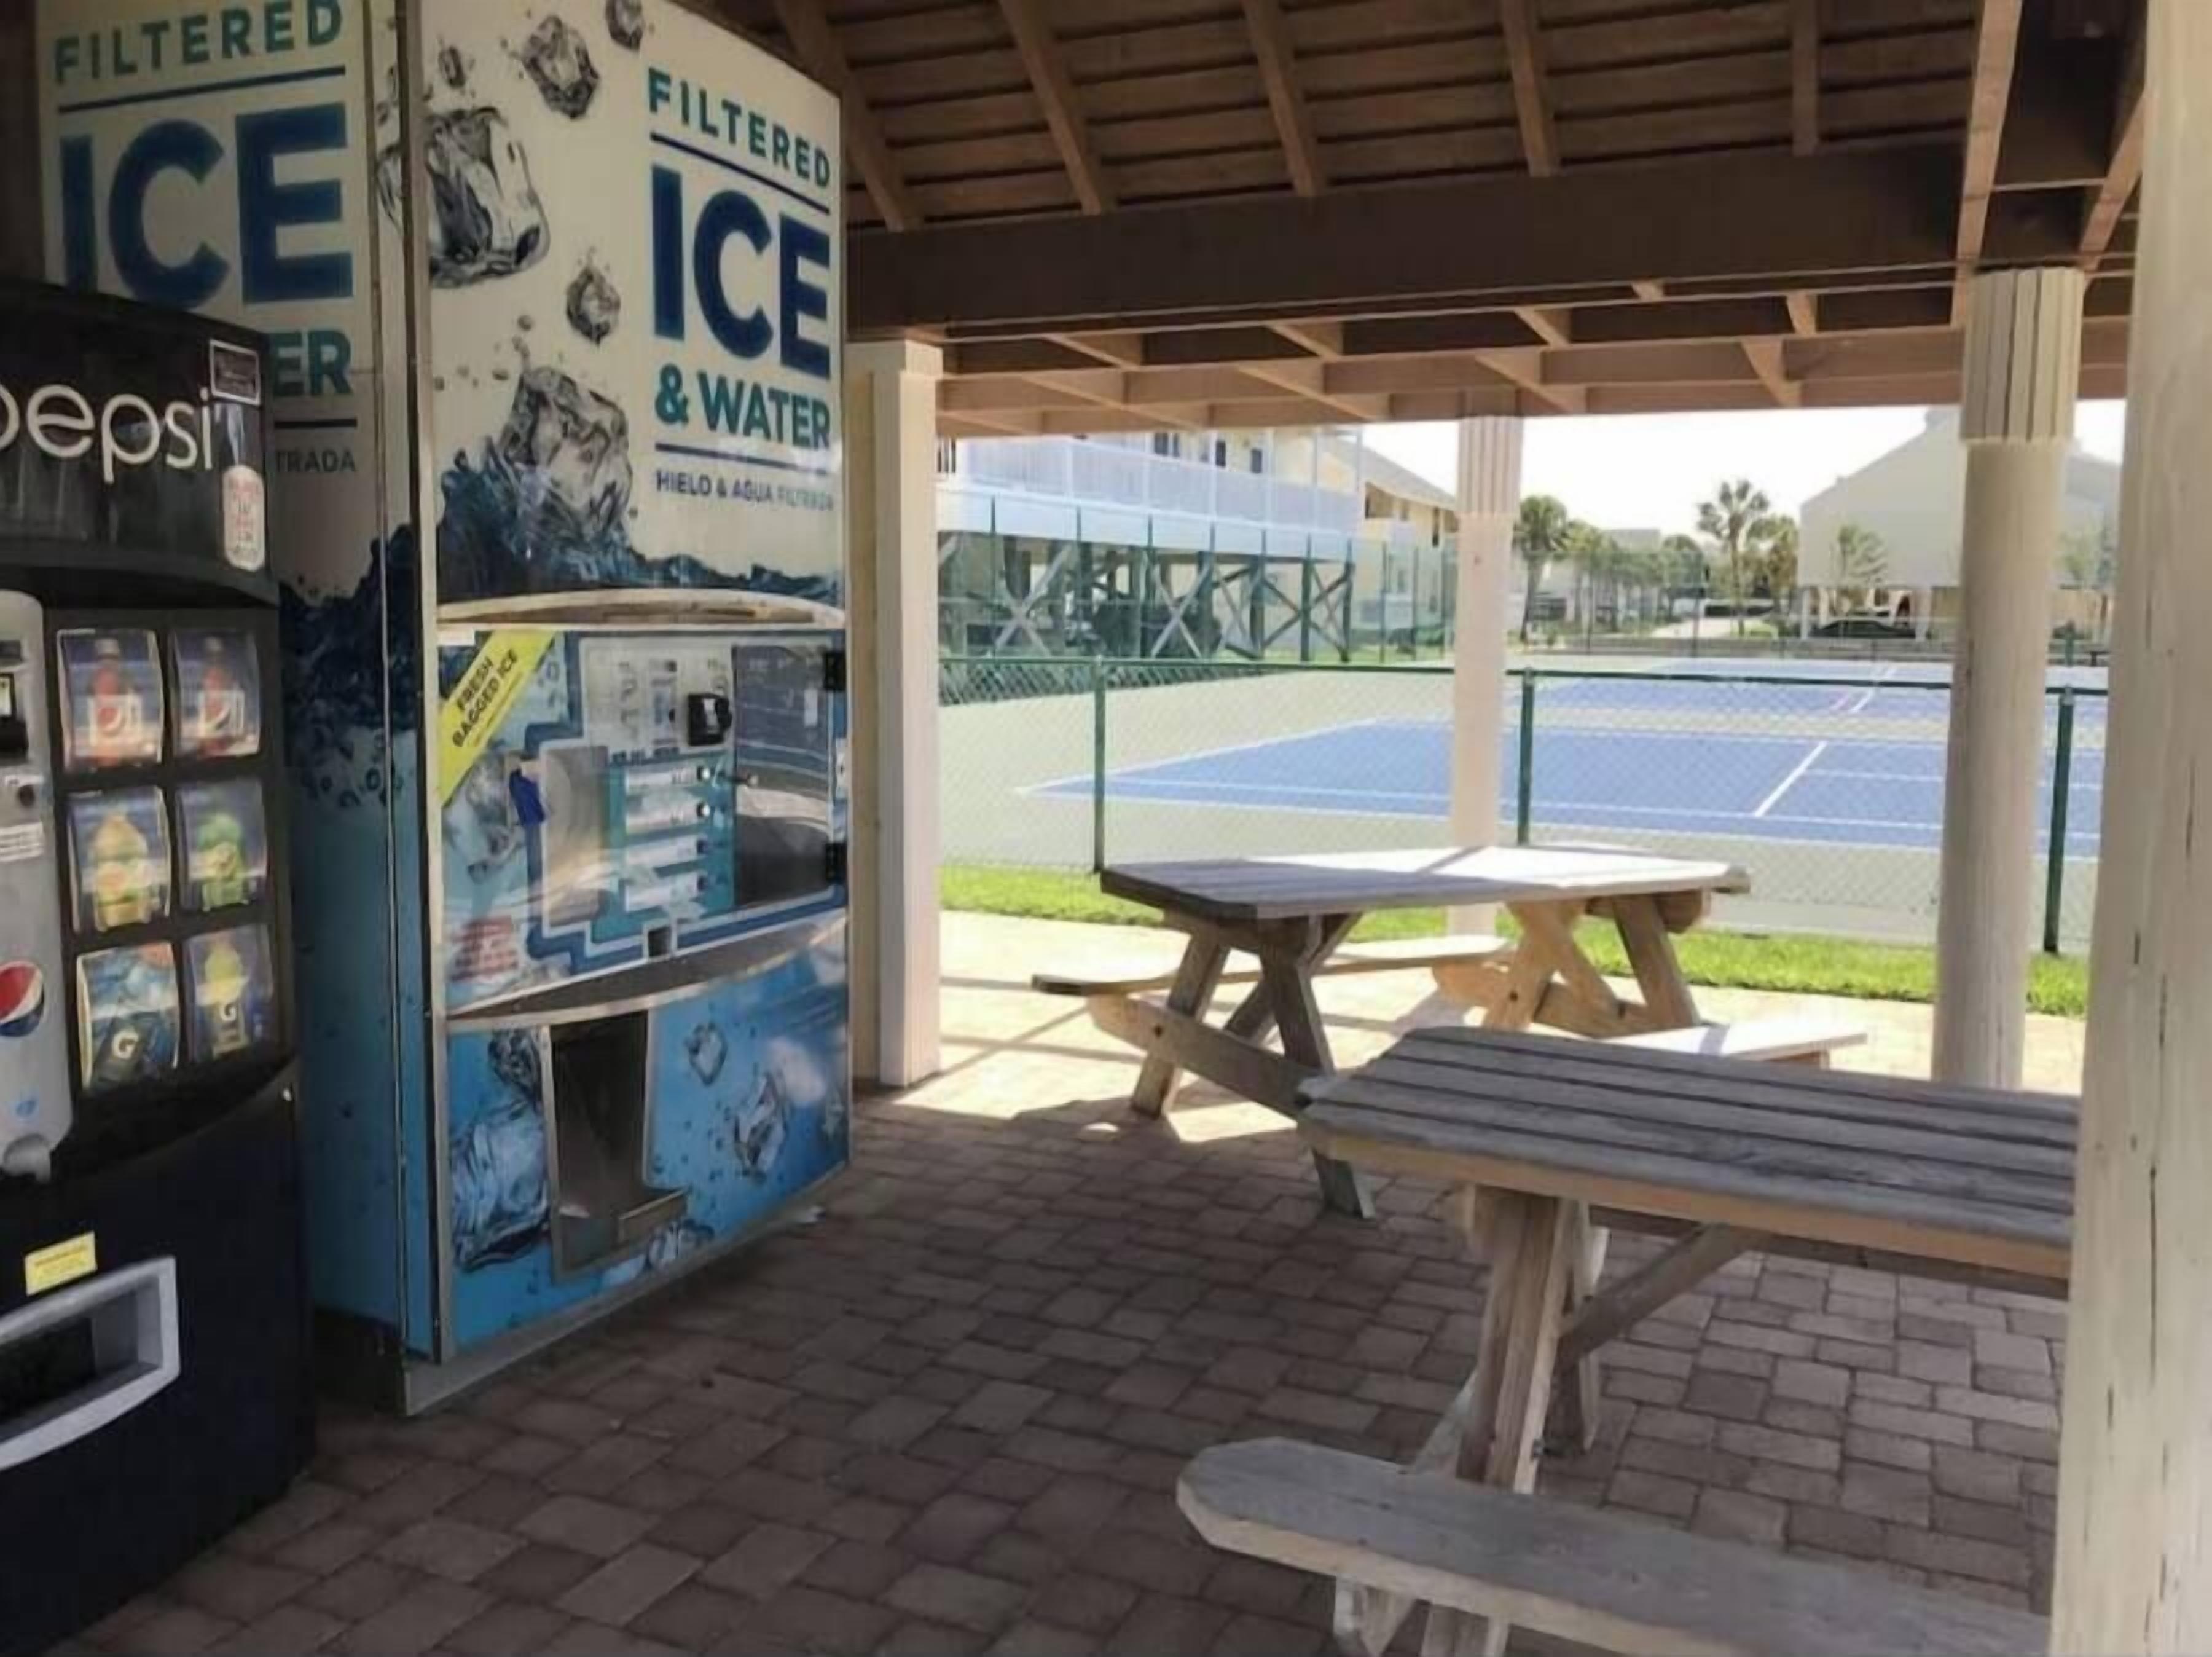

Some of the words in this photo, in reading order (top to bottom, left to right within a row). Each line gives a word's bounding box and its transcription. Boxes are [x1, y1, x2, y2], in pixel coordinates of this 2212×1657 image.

[55, 0, 343, 85] FILTERED
[648, 66, 831, 189] FILTERED
[59, 103, 354, 309] ICE
[651, 163, 831, 380] ICE
[0, 384, 212, 484] epsi
[655, 364, 689, 425] &
[697, 371, 831, 451] WATER
[656, 468, 712, 497] HIELO
[452, 677, 499, 748] BAGGED
[497, 649, 518, 678] ICE
[457, 656, 493, 711] FRESH
[111, 1029, 139, 1060] G
